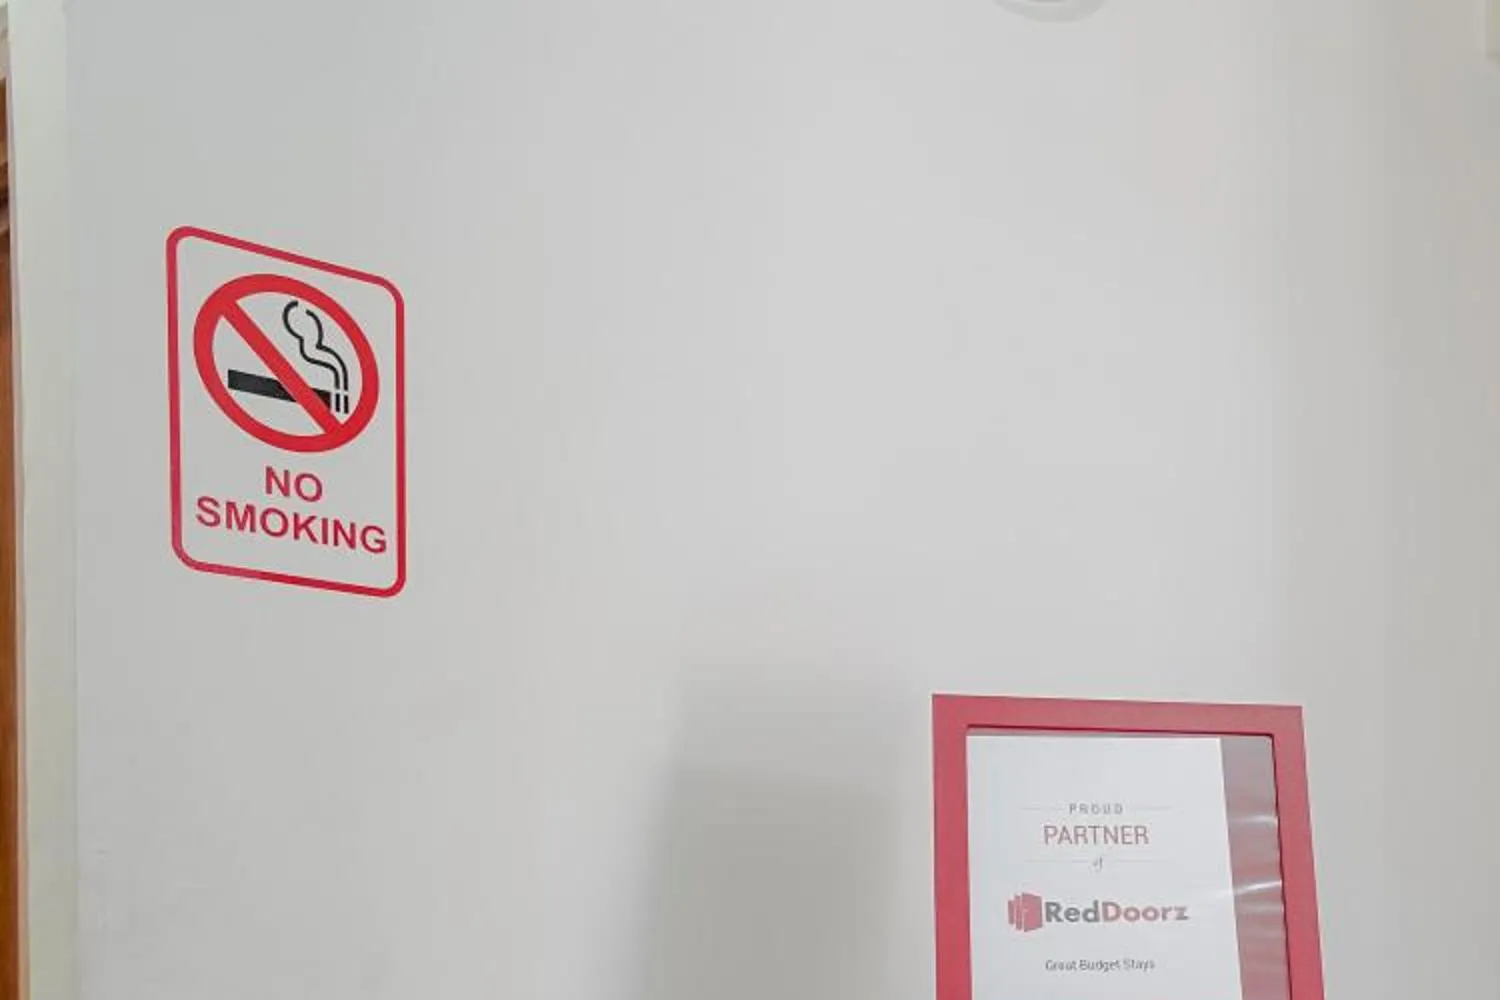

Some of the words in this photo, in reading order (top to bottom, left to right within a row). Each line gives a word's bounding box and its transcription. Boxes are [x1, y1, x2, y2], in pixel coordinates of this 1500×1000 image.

[265, 466, 323, 503] NO
[196, 495, 388, 555] SMOKING
[1068, 802, 1124, 816] PROUD
[1043, 824, 1150, 845] PARTNER
[1044, 899, 1190, 924] RedDoorz
[1045, 959, 1077, 971] Great
[1079, 959, 1121, 973] Budget
[1123, 958, 1156, 973] Stays
